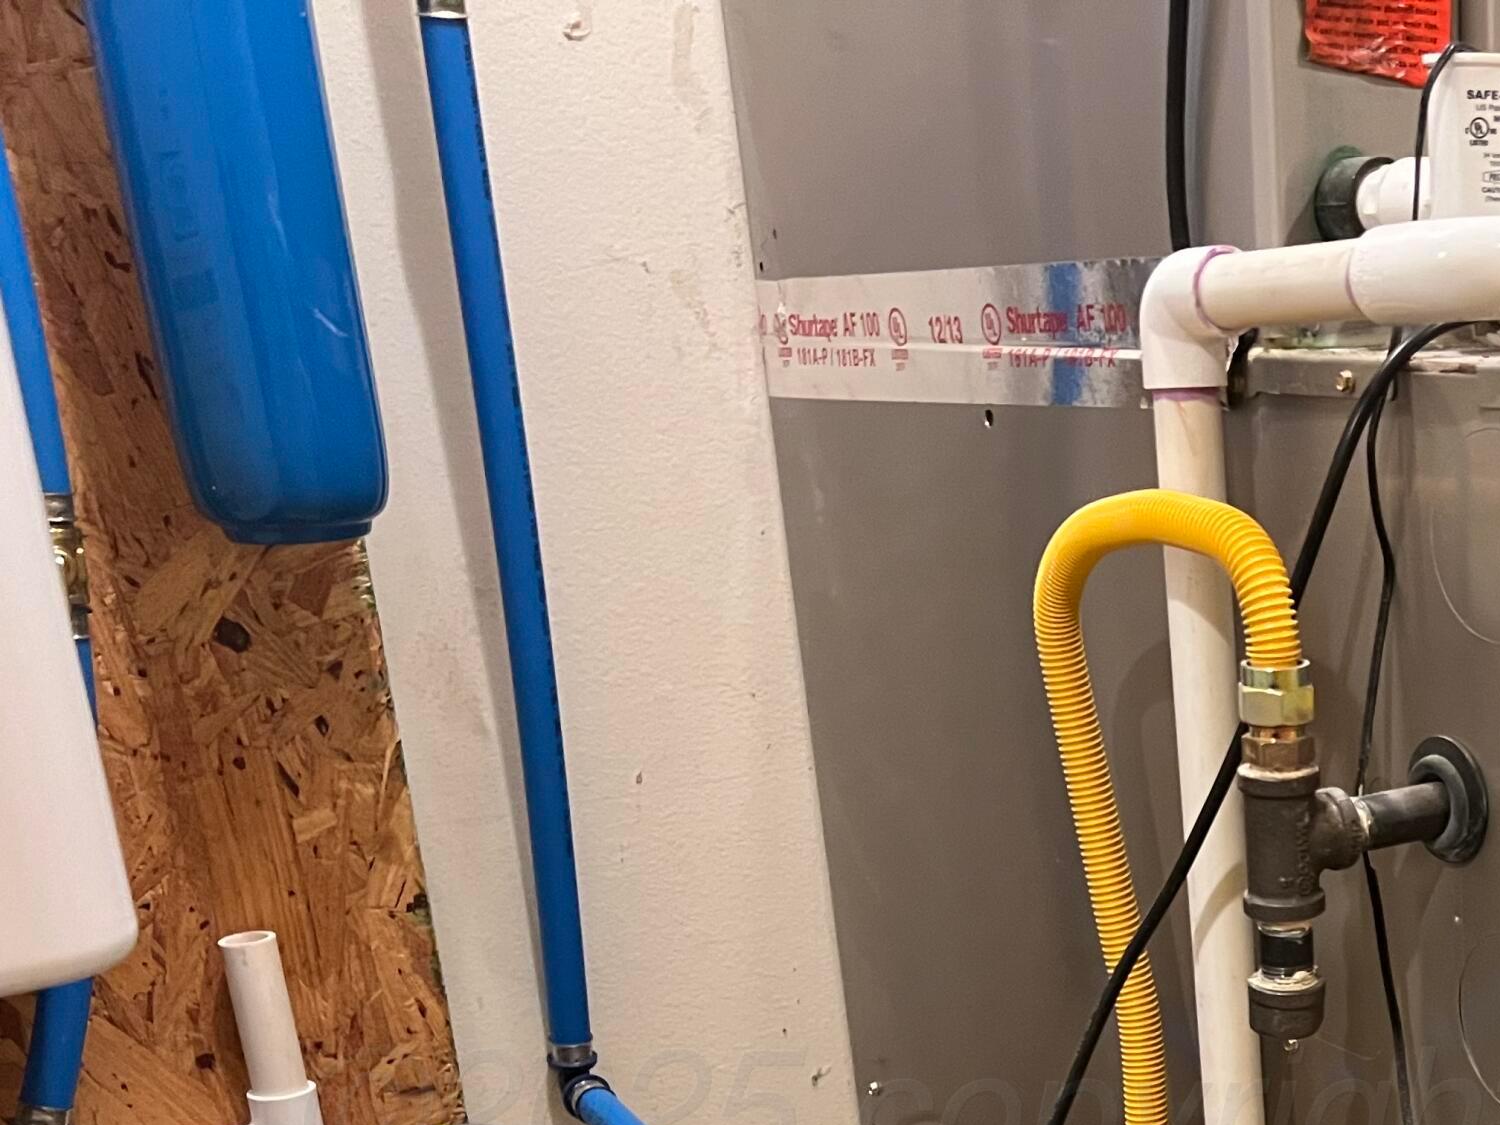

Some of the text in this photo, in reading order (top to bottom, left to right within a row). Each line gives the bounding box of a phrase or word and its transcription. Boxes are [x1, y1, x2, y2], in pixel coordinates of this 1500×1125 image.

[788, 312, 880, 342] Shurtape AF 100
[928, 315, 963, 344] 12/13
[1006, 303, 1127, 340] Shurtape AF 100
